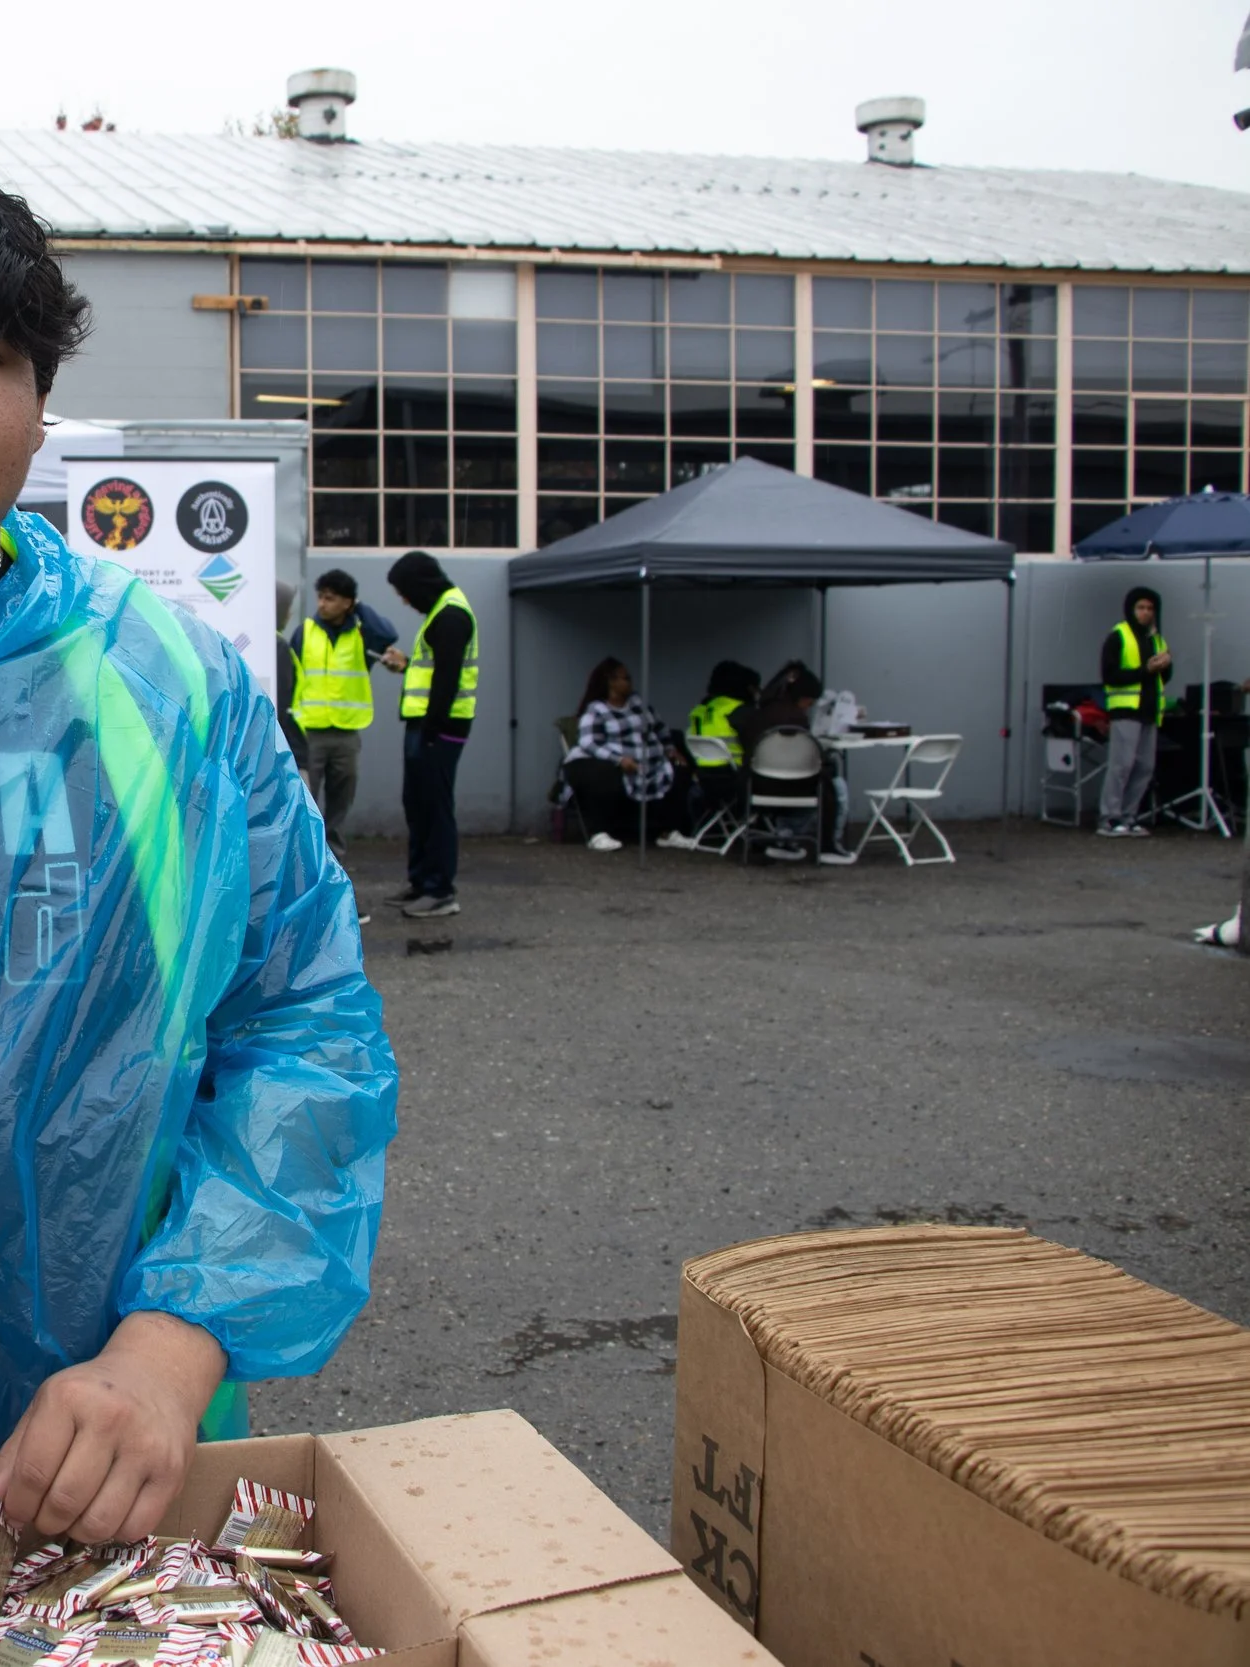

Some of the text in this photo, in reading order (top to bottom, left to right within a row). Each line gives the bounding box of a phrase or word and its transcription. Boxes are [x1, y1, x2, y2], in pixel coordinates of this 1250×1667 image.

[163, 569, 176, 577] OF
[98, 1631, 167, 1639] GHIRARDELLI
[6, 1630, 54, 1651] GHIRARDELLI
